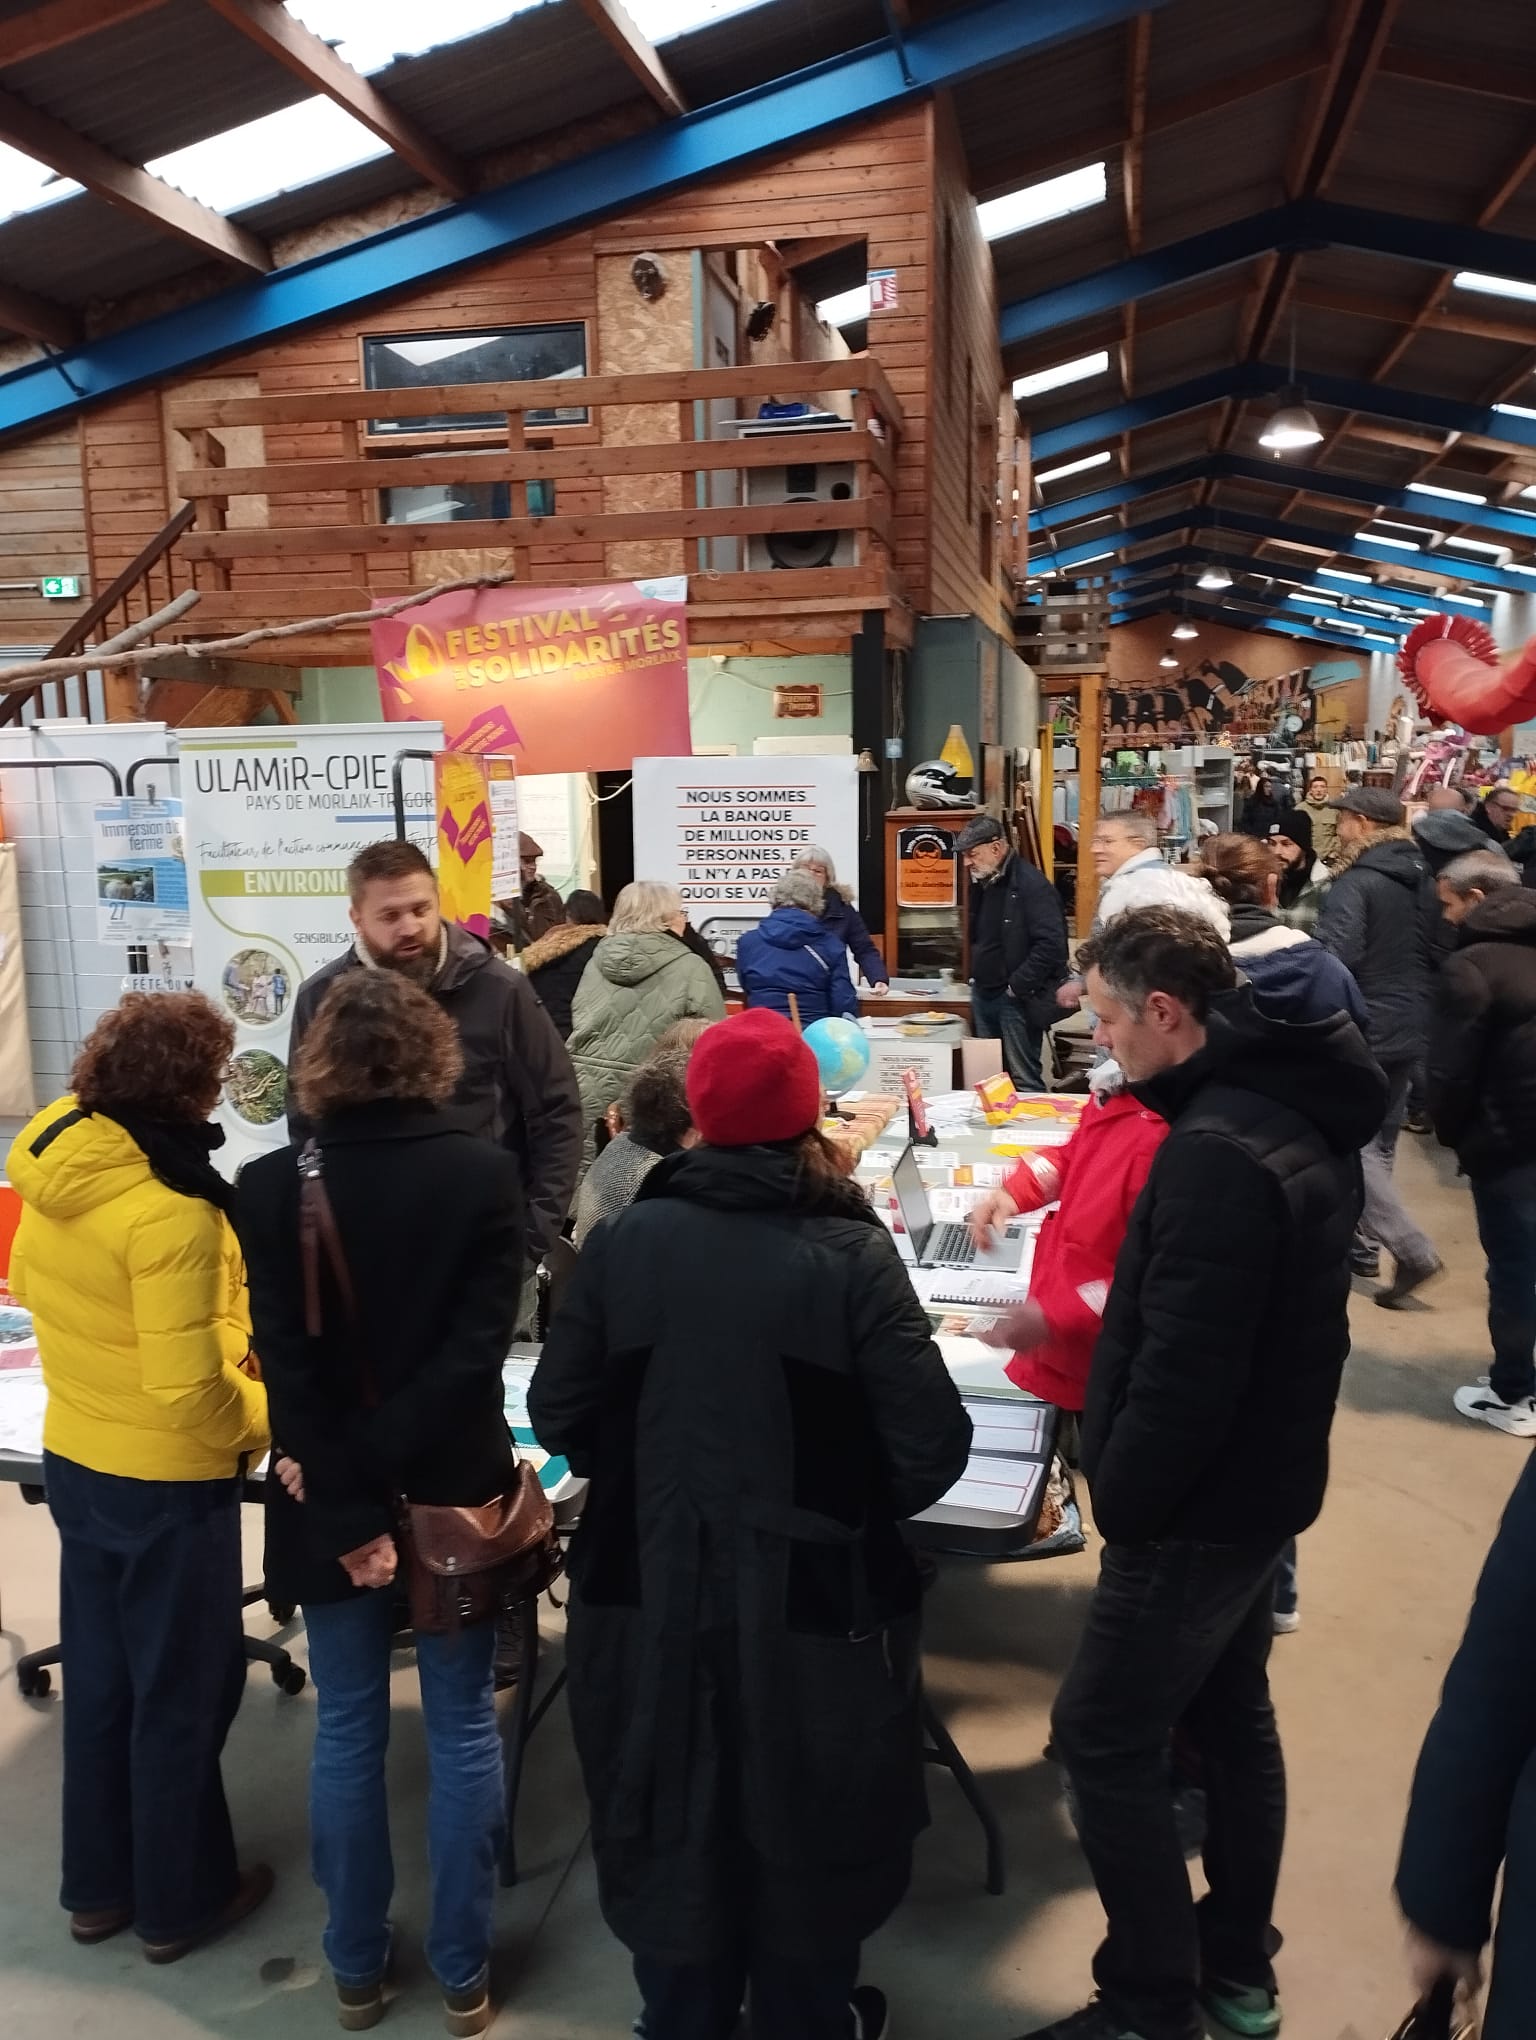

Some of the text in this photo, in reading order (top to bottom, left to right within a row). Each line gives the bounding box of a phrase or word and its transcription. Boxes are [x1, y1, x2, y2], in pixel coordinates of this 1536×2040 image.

[445, 606, 599, 659] FESTIVAL
[468, 614, 683, 688] SOLIDARITÉS
[246, 792, 433, 811] PAYS DE MORLAIX-TRGOR
[686, 790, 806, 803] NOUS SOMMES
[701, 809, 792, 822] LA BANQUE
[101, 822, 164, 838] Immersion
[685, 829, 809, 842] DE MILLIONS DE
[129, 837, 164, 851] ferme
[686, 849, 785, 861] PERSONNES,
[689, 868, 700, 880] IL
[706, 867, 732, 880] N'Y
[736, 868, 747, 880] A
[751, 867, 780, 880] PAS
[681, 887, 720, 899] QUOI
[725, 887, 743, 899] SE
[109, 902, 126, 920] 27
[293, 932, 359, 944] SENSIBILISAT
